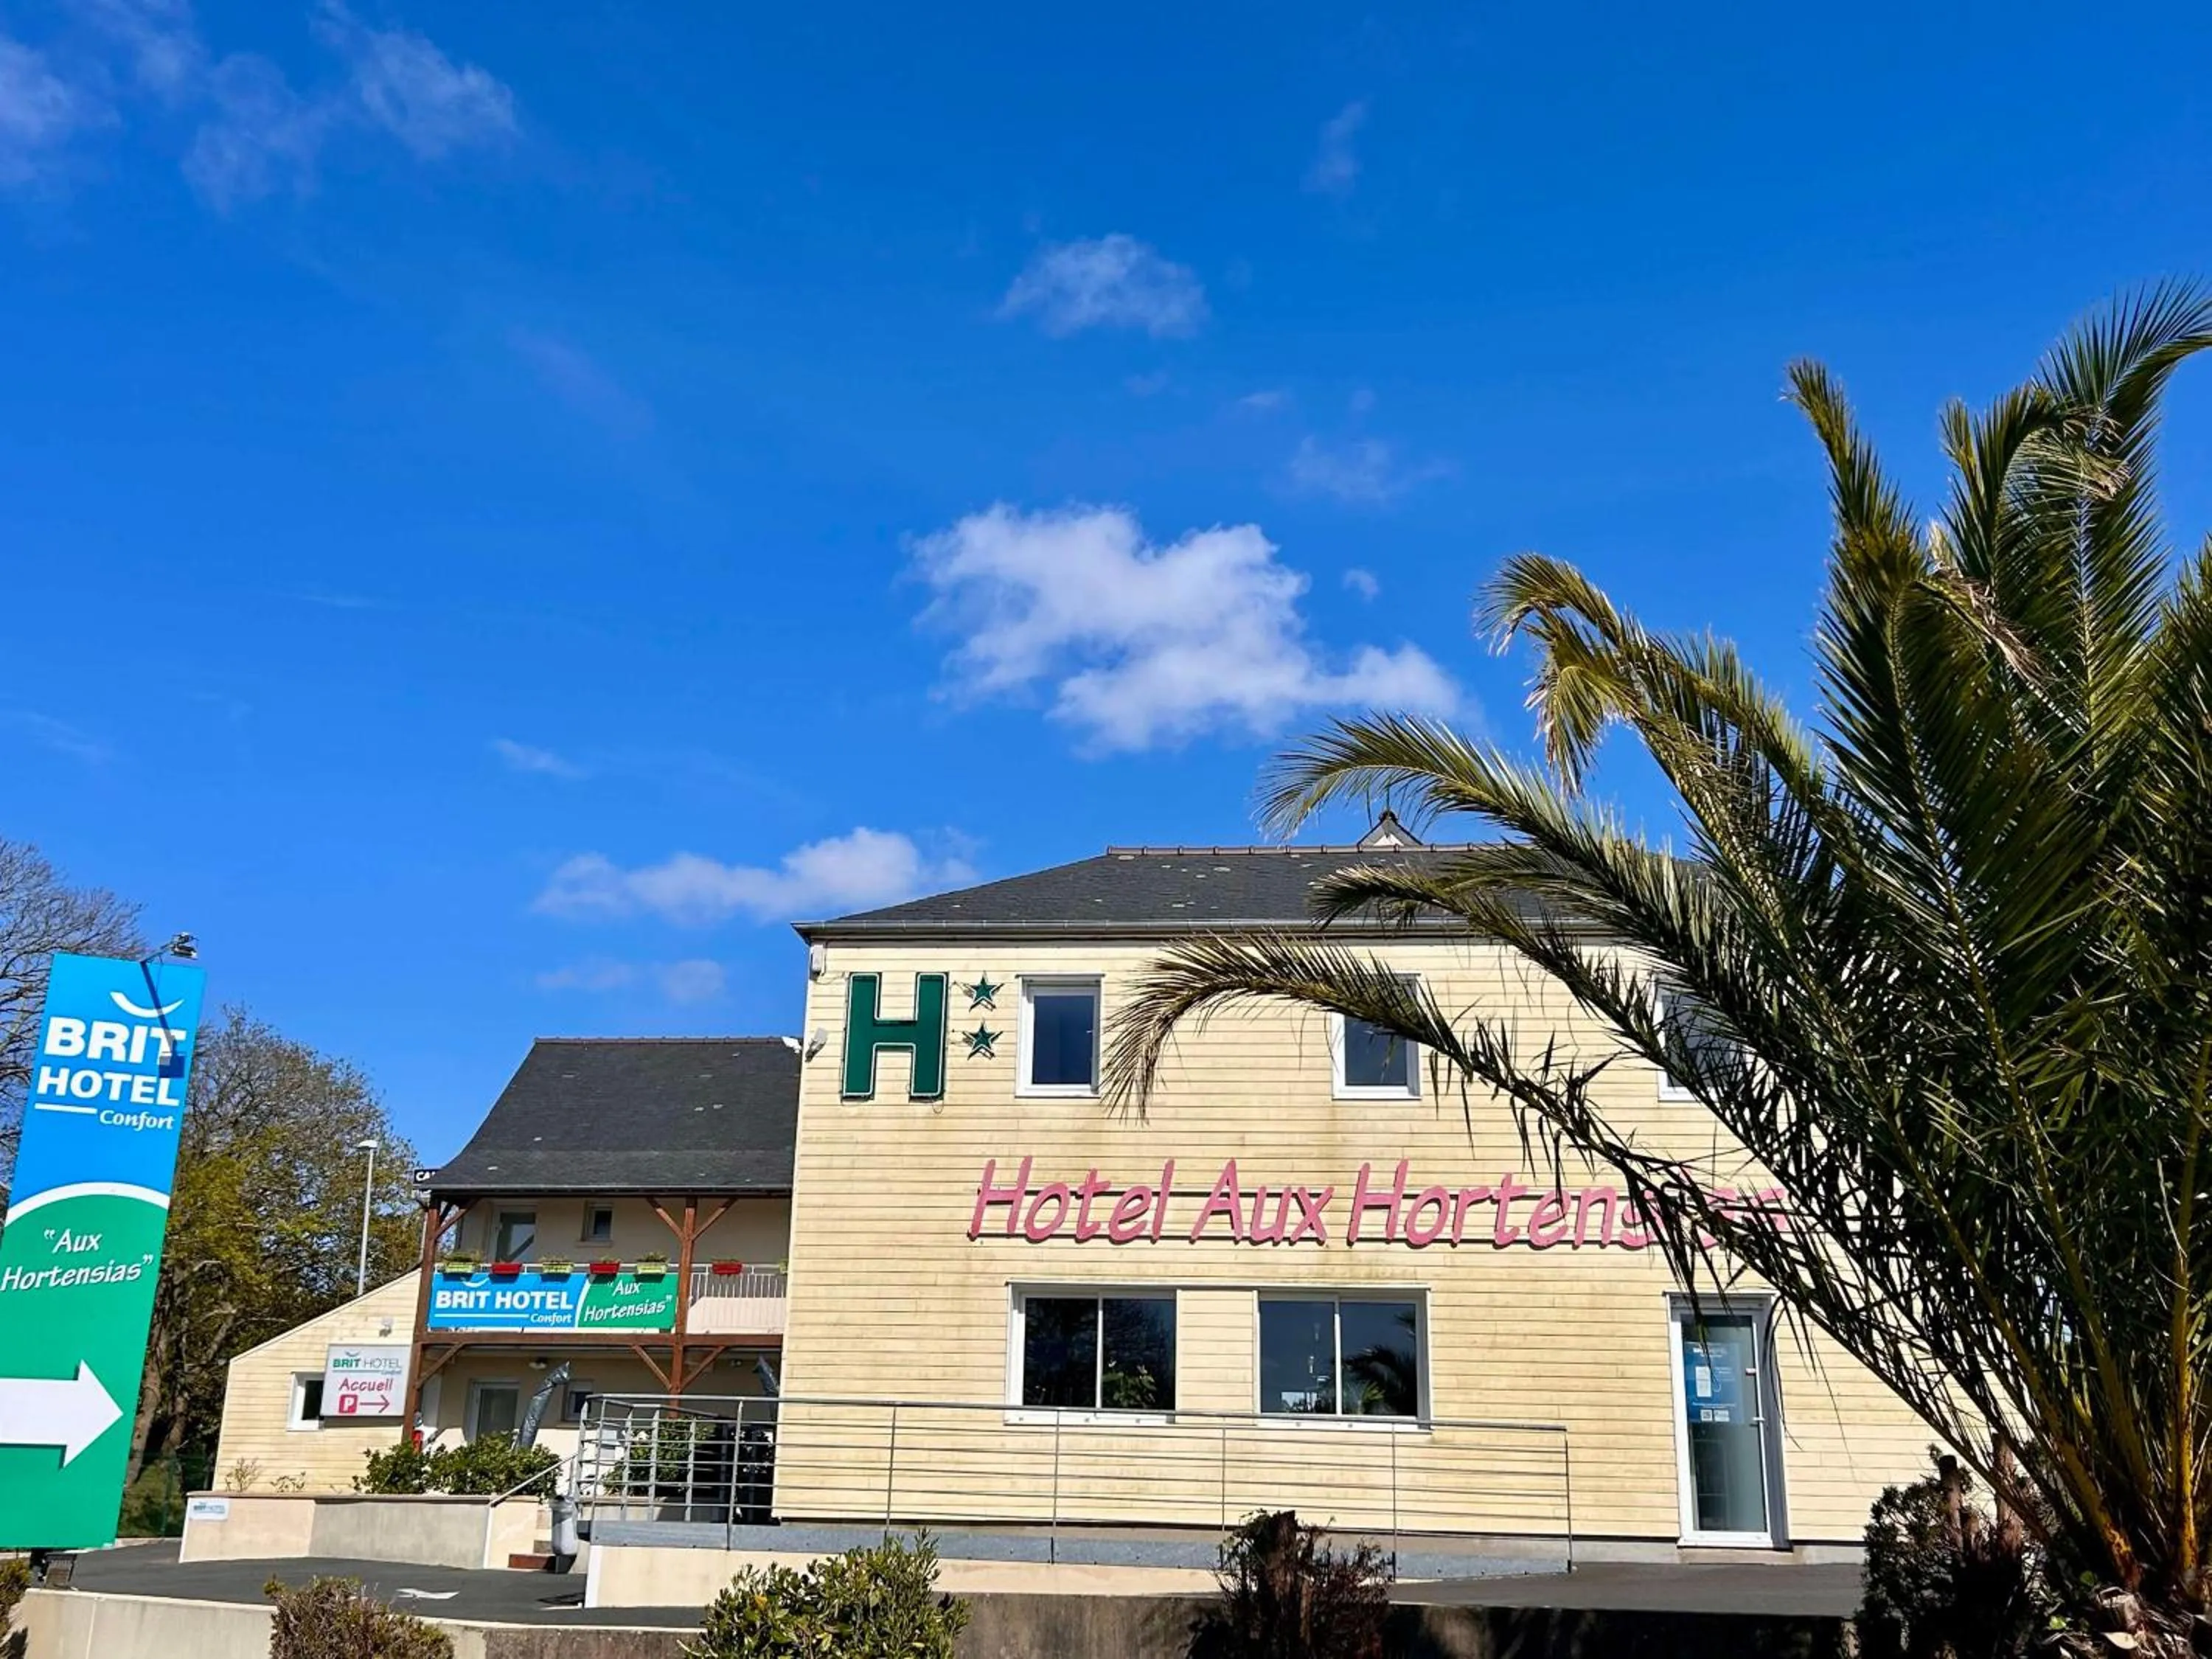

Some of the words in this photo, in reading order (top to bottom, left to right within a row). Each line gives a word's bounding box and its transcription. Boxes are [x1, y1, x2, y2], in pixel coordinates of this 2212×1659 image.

[44, 1017, 187, 1065] BRIT
[843, 973, 947, 1097] H
[37, 1065, 180, 1106] HOTEL
[100, 1110, 175, 1132] Confort
[969, 1155, 1175, 1242] Hotel
[1190, 1157, 1335, 1242] Aux
[435, 1290, 490, 1309] BRIT
[495, 1291, 573, 1310] HOTEL
[530, 1312, 571, 1324] Confort
[333, 1358, 361, 1368] BRIT
[364, 1357, 402, 1369] HOTEL
[338, 1377, 393, 1391] Accueil
[343, 1397, 355, 1413] P
